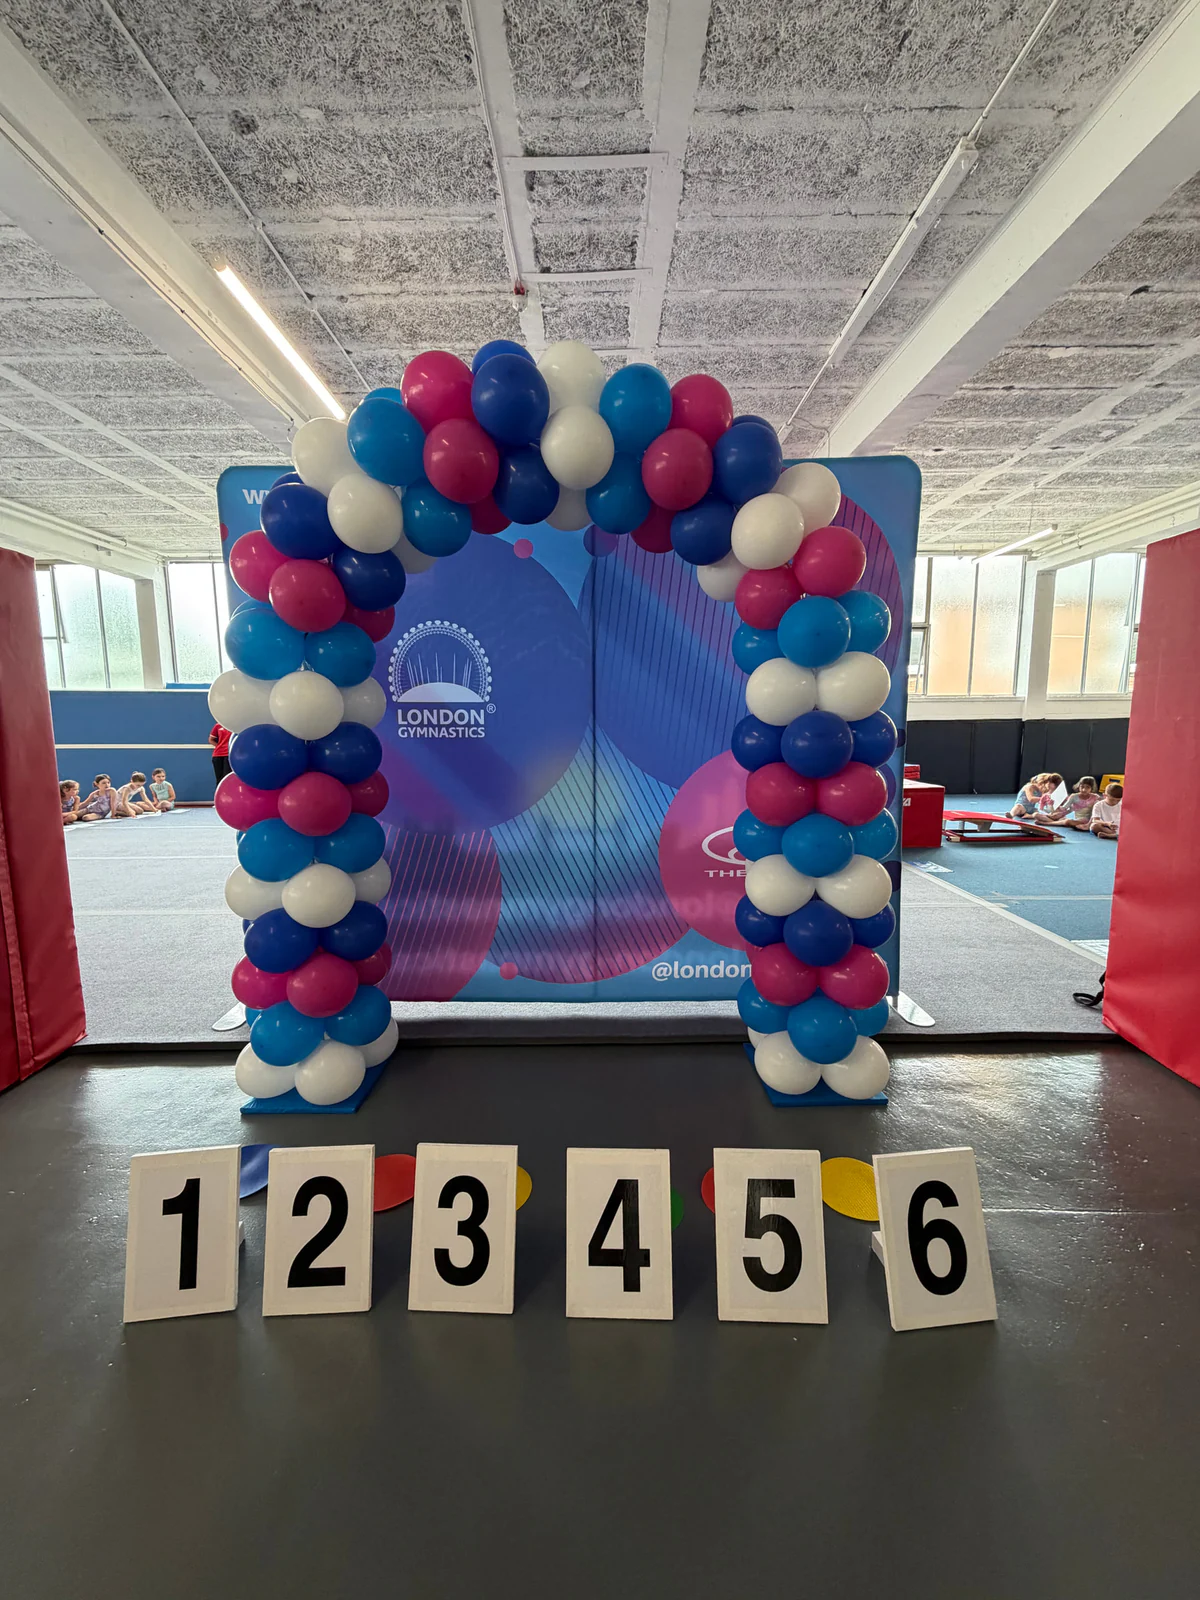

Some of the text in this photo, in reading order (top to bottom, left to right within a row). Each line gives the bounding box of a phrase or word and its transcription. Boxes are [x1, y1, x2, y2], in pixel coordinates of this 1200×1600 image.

[397, 709, 485, 725] LONDON
[397, 726, 486, 738] GYMNASTICS
[163, 1178, 200, 1290] 1
[288, 1176, 349, 1288] 2
[434, 1176, 490, 1286] 3
[589, 1179, 651, 1292] 4
[743, 1179, 803, 1292] 5
[908, 1181, 968, 1295] 6
